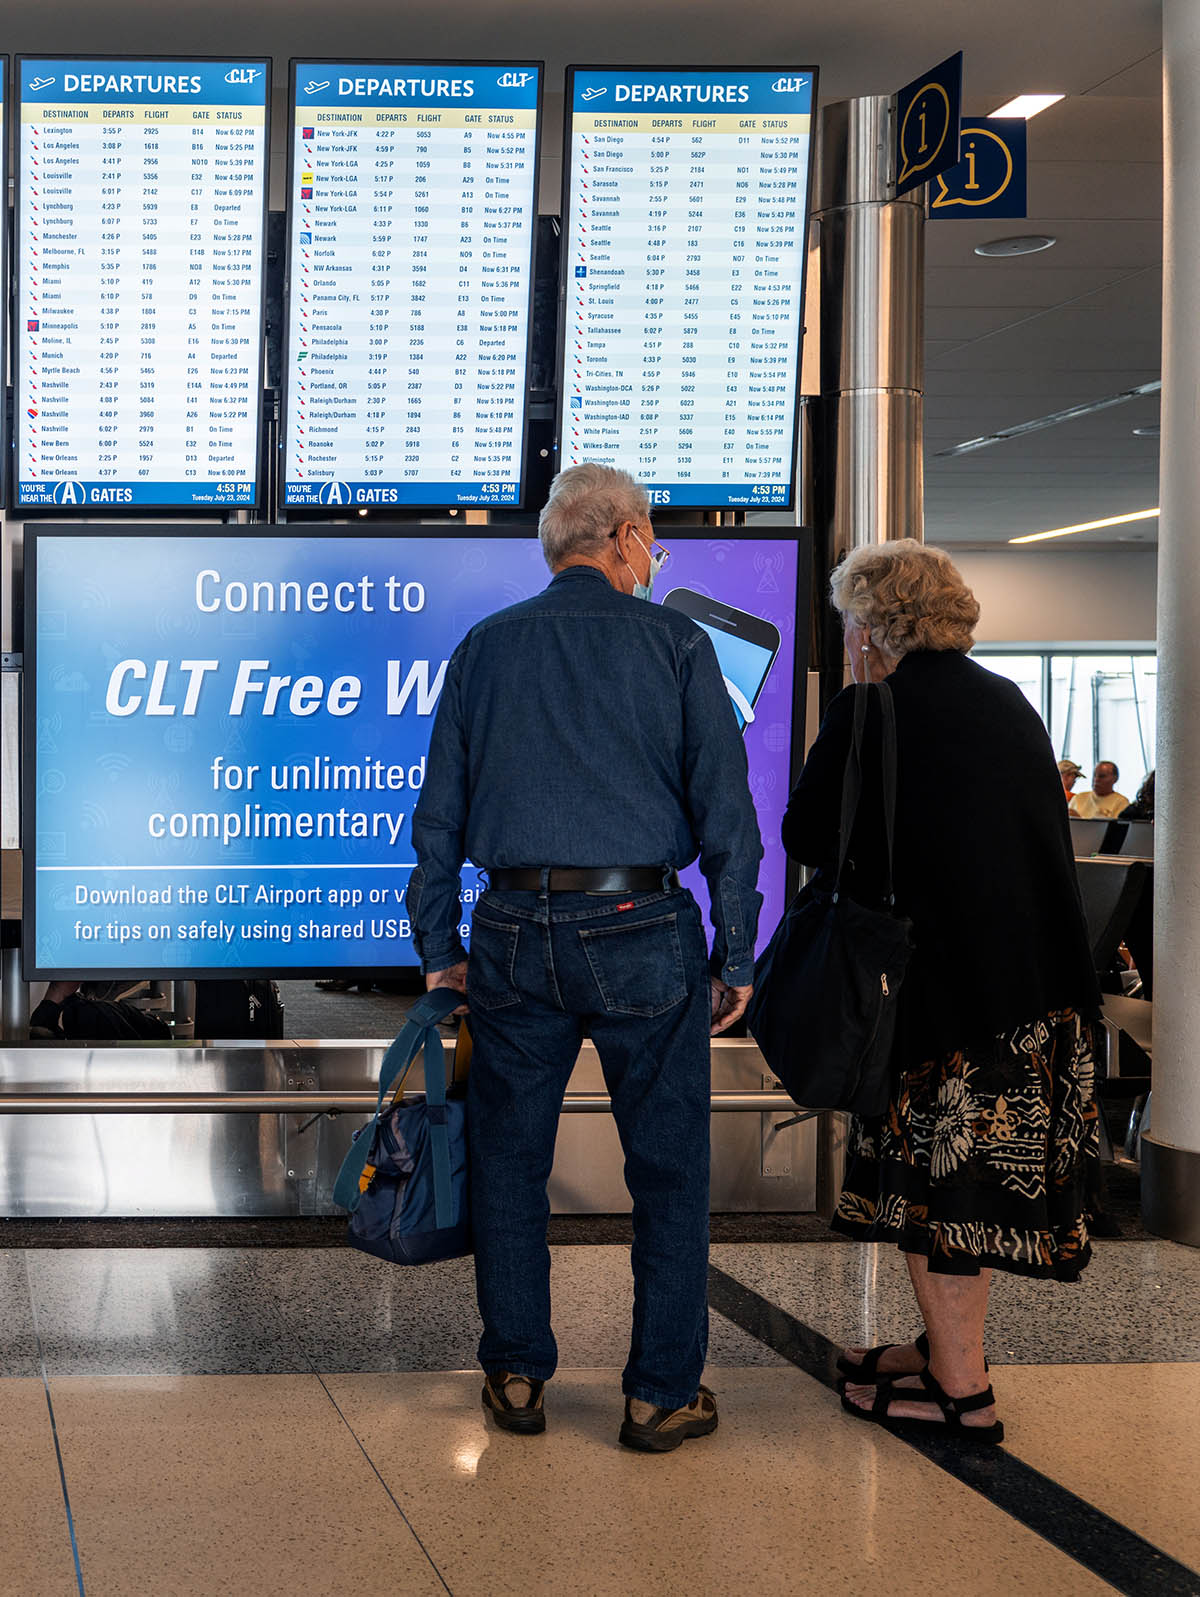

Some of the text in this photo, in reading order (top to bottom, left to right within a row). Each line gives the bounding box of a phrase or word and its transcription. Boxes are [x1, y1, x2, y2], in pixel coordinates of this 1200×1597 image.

[231, 69, 256, 83] CLT
[503, 73, 527, 87] CLT
[65, 75, 201, 93] DEPARTURES
[339, 78, 473, 97] DEPARTURES
[778, 78, 802, 92] CLT
[616, 85, 749, 102] DEPARTURES
[43, 110, 88, 118] DESTINATION
[91, 488, 132, 502] GATES
[217, 484, 251, 492] 4:53 PM
[357, 489, 397, 502] GATES
[482, 484, 515, 492] 4:53 PM
[752, 486, 785, 494] 4:53 PM
[197, 569, 426, 613] Connect to
[106, 659, 218, 716] CLT
[229, 660, 361, 715] Free
[211, 757, 425, 789] for unlimited
[148, 804, 399, 845] complimentary
[76, 885, 171, 904] Download
[177, 885, 207, 903] the
[216, 885, 249, 903] CLT
[255, 885, 322, 907] Airport
[328, 890, 362, 907] app
[370, 890, 389, 902] or
[74, 920, 411, 943] for tips on safely using shared USB
